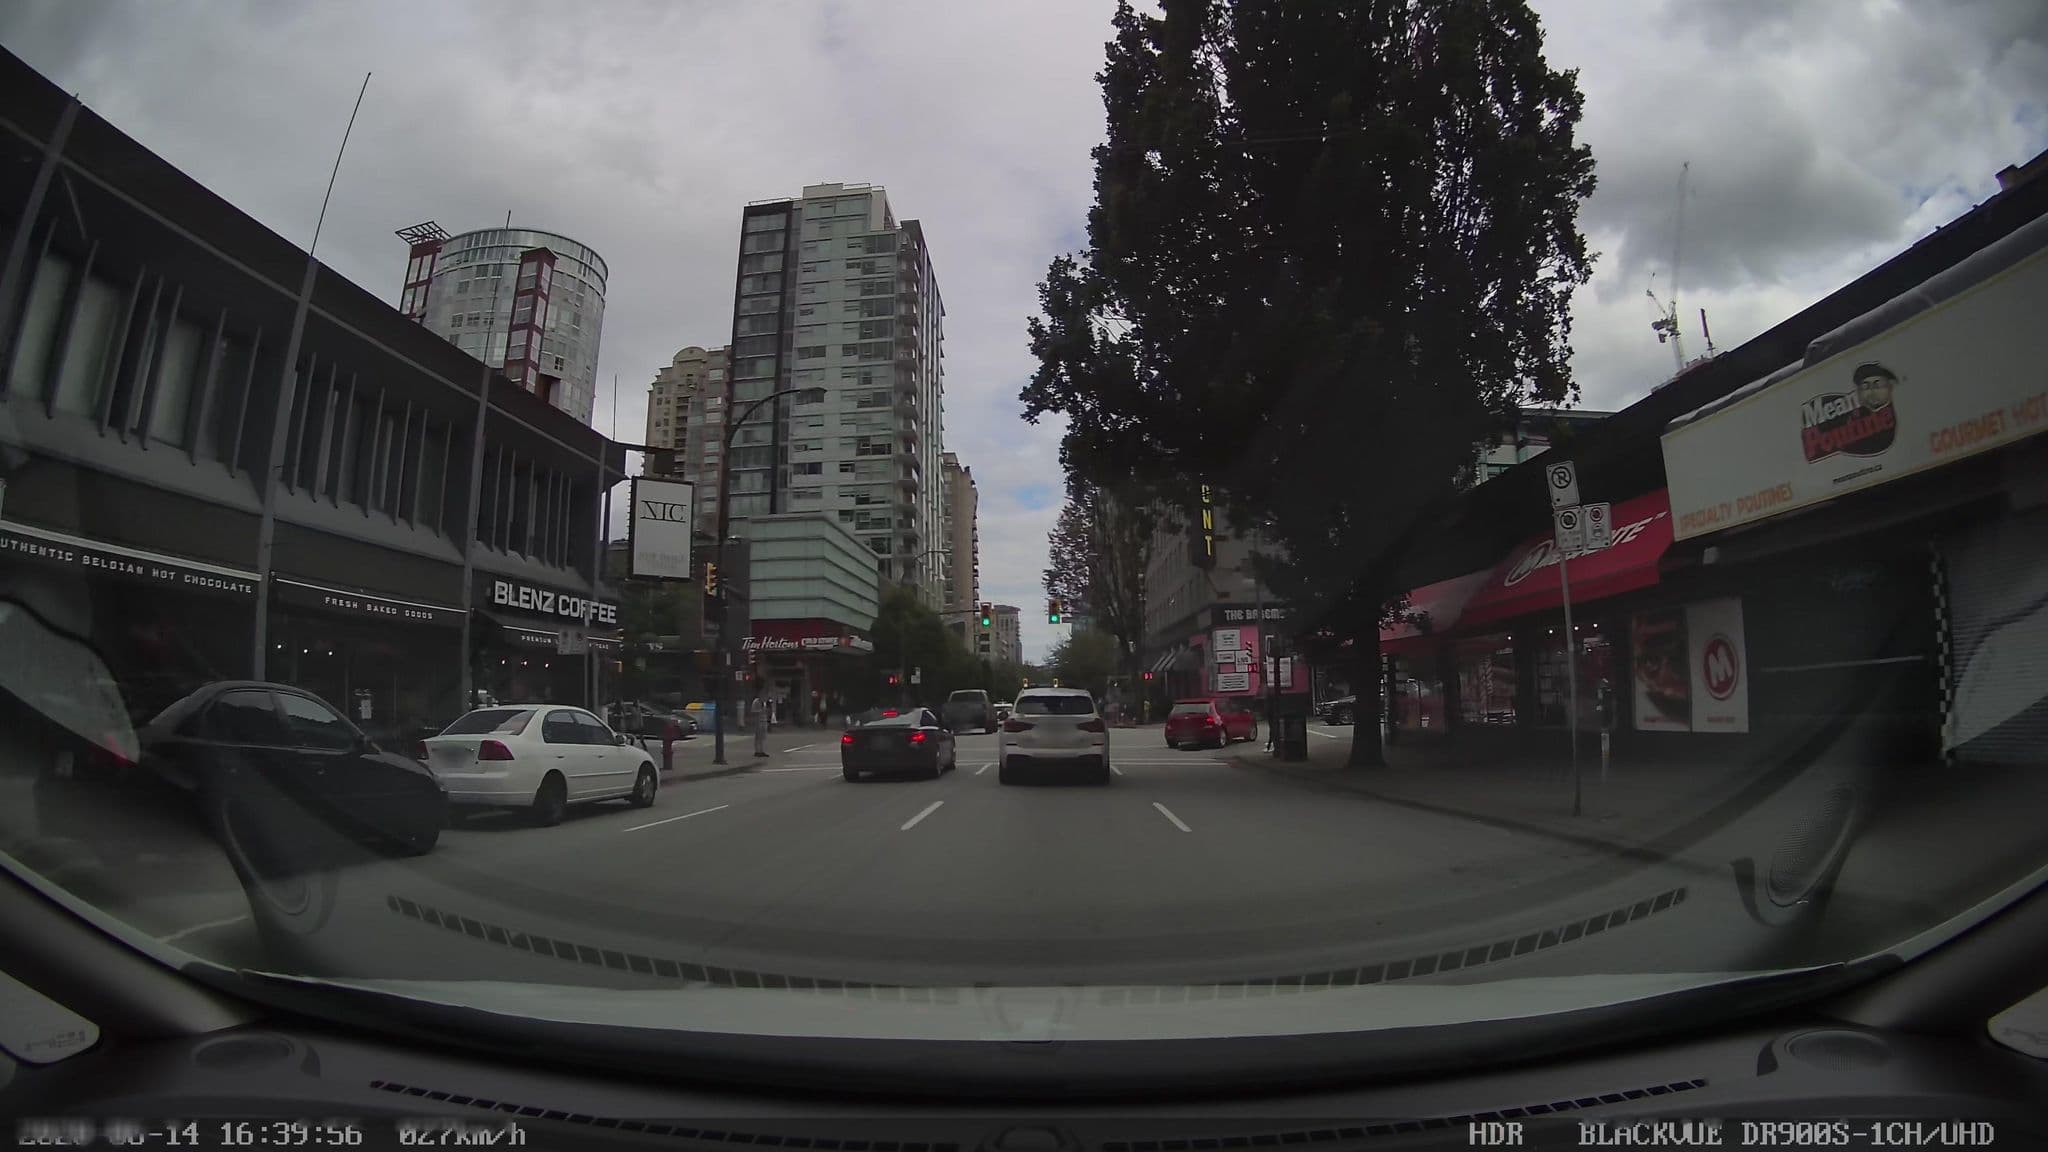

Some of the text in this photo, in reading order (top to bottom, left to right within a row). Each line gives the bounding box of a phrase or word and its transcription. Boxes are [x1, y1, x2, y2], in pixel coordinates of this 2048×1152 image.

[1801, 393, 1859, 428] Mean
[0, 537, 74, 562] UTHENTIC
[152, 570, 176, 580] HOT
[184, 574, 252, 593] CHOCOLATE
[325, 597, 433, 620] FRESH BAKED GOODS
[494, 580, 617, 624] BLENZ COFFEE
[1224, 609, 1244, 621] THE
[742, 637, 761, 650] Tim
[761, 636, 799, 649] Hortons
